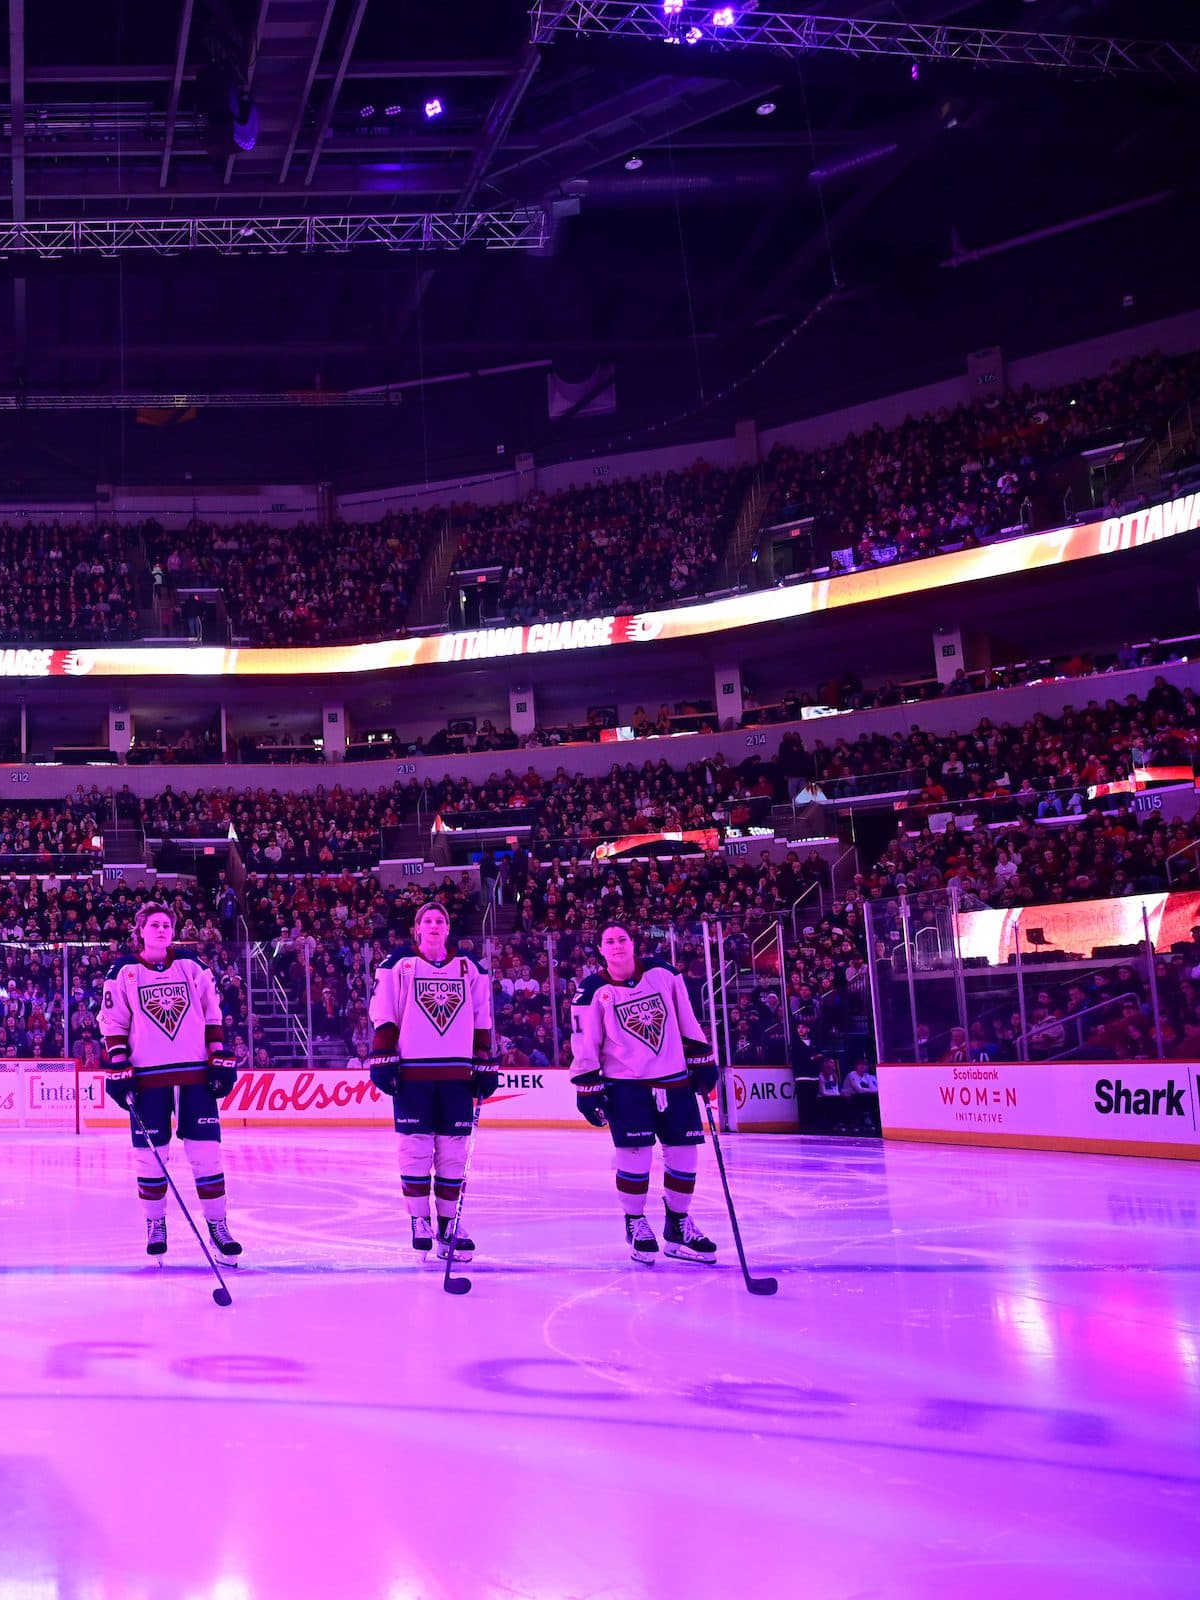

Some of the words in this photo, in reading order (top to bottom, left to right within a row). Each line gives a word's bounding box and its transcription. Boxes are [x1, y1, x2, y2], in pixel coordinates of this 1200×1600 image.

[440, 626, 523, 661] OTTAWA
[526, 616, 615, 653] CHARGE
[943, 646, 955, 656] 28
[746, 734, 766, 746] 214
[398, 763, 415, 774] 213
[10, 772, 29, 782] 212
[1137, 796, 1162, 810] 115
[105, 869, 123, 880] 112
[404, 864, 423, 875] 113
[142, 985, 186, 1003] VICTOIRE
[418, 982, 461, 996] VICTOIRE
[620, 998, 663, 1020] VICTOIRE
[497, 1072, 544, 1089] CHEK
[953, 1069, 998, 1080] Scotiabank
[41, 1082, 95, 1101] intact
[220, 1073, 381, 1110] Molson
[750, 1082, 777, 1100] AIR
[1094, 1079, 1186, 1116] Shark
[955, 1112, 1003, 1123] INITIATIVE
